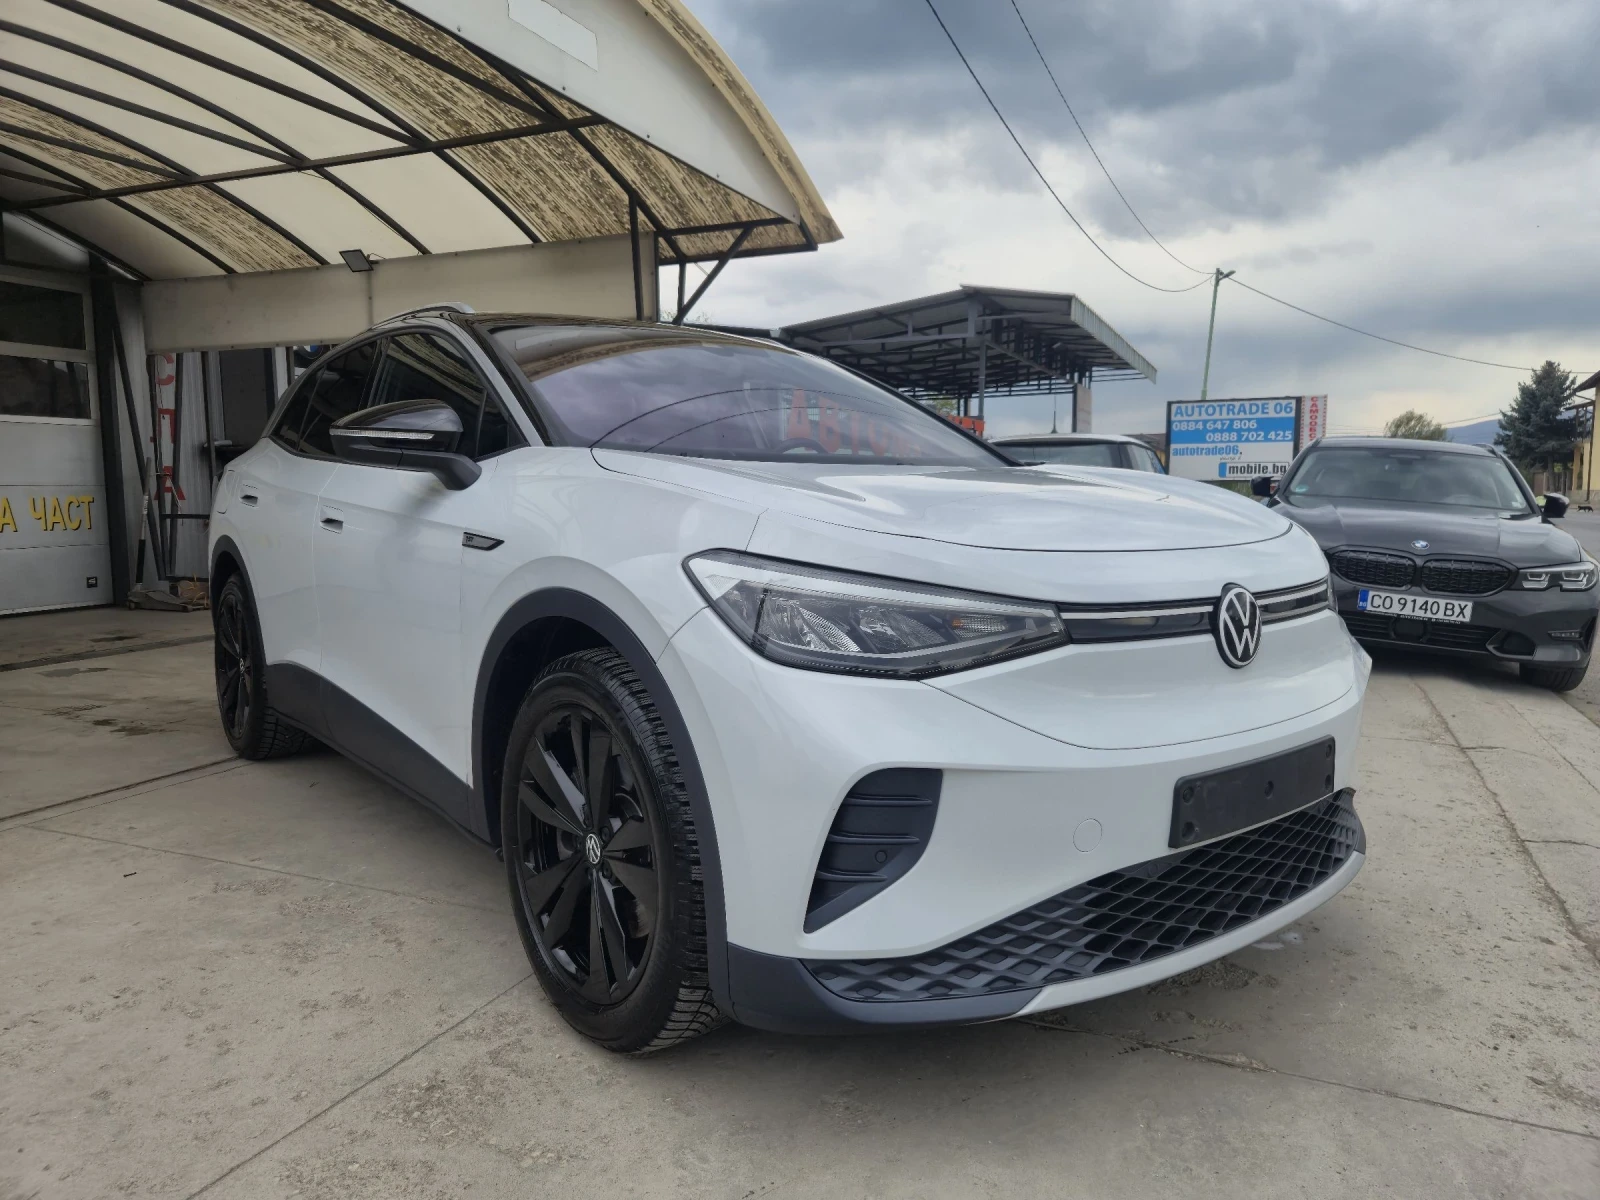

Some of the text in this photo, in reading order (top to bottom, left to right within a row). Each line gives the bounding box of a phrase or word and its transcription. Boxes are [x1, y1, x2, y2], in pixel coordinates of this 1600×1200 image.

[1174, 402, 1293, 417] AUTOTRADE 06
[1172, 419, 1257, 431] 0884 647 806
[1206, 430, 1292, 442] 0888 702 425
[1228, 463, 1287, 475] mobile.bg
[29, 495, 95, 531] ЧАСТ
[1370, 594, 1393, 610] CO
[1397, 597, 1440, 615] 9140
[1443, 602, 1468, 619] BX
